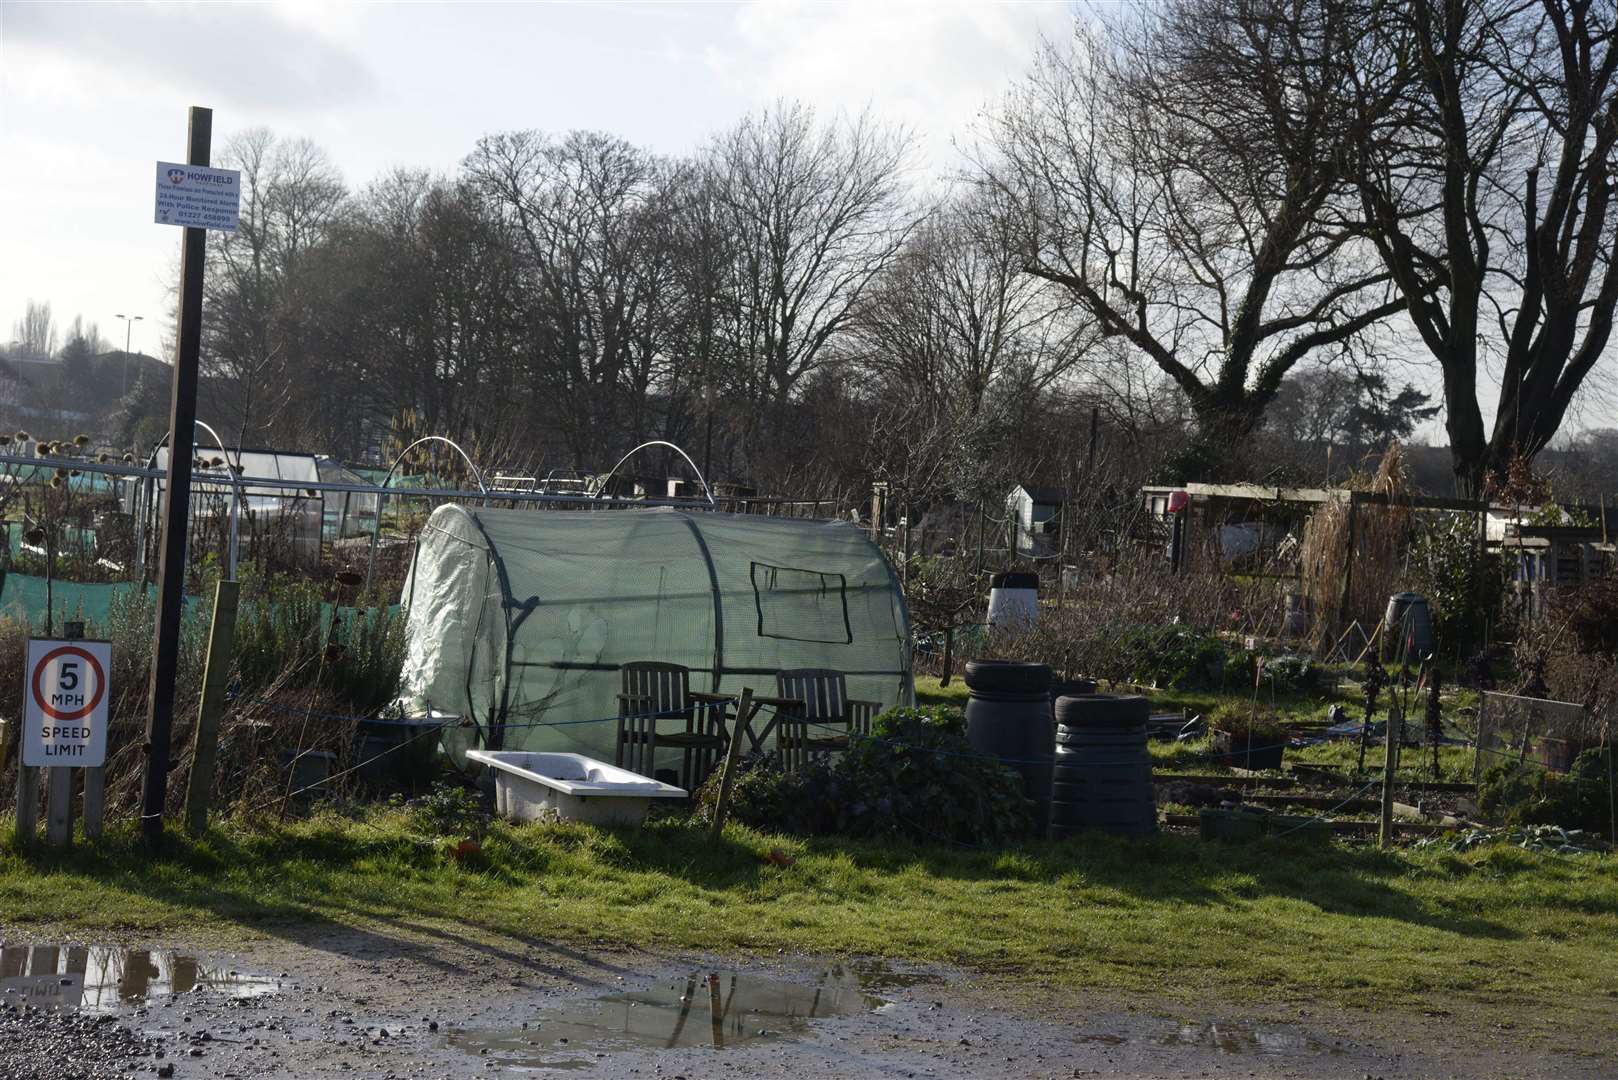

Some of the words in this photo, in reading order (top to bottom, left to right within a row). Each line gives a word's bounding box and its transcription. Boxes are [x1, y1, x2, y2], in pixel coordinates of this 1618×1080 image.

[187, 172, 232, 184] HOWFIELD
[186, 196, 218, 205] Monitored
[158, 200, 175, 208] With
[177, 203, 200, 211] Police
[202, 206, 237, 215] Response
[178, 211, 201, 219] 01227
[60, 663, 78, 690] 5
[52, 694, 84, 706] MPH
[42, 727, 91, 739] SPEED
[46, 745, 86, 756] LIMIT
